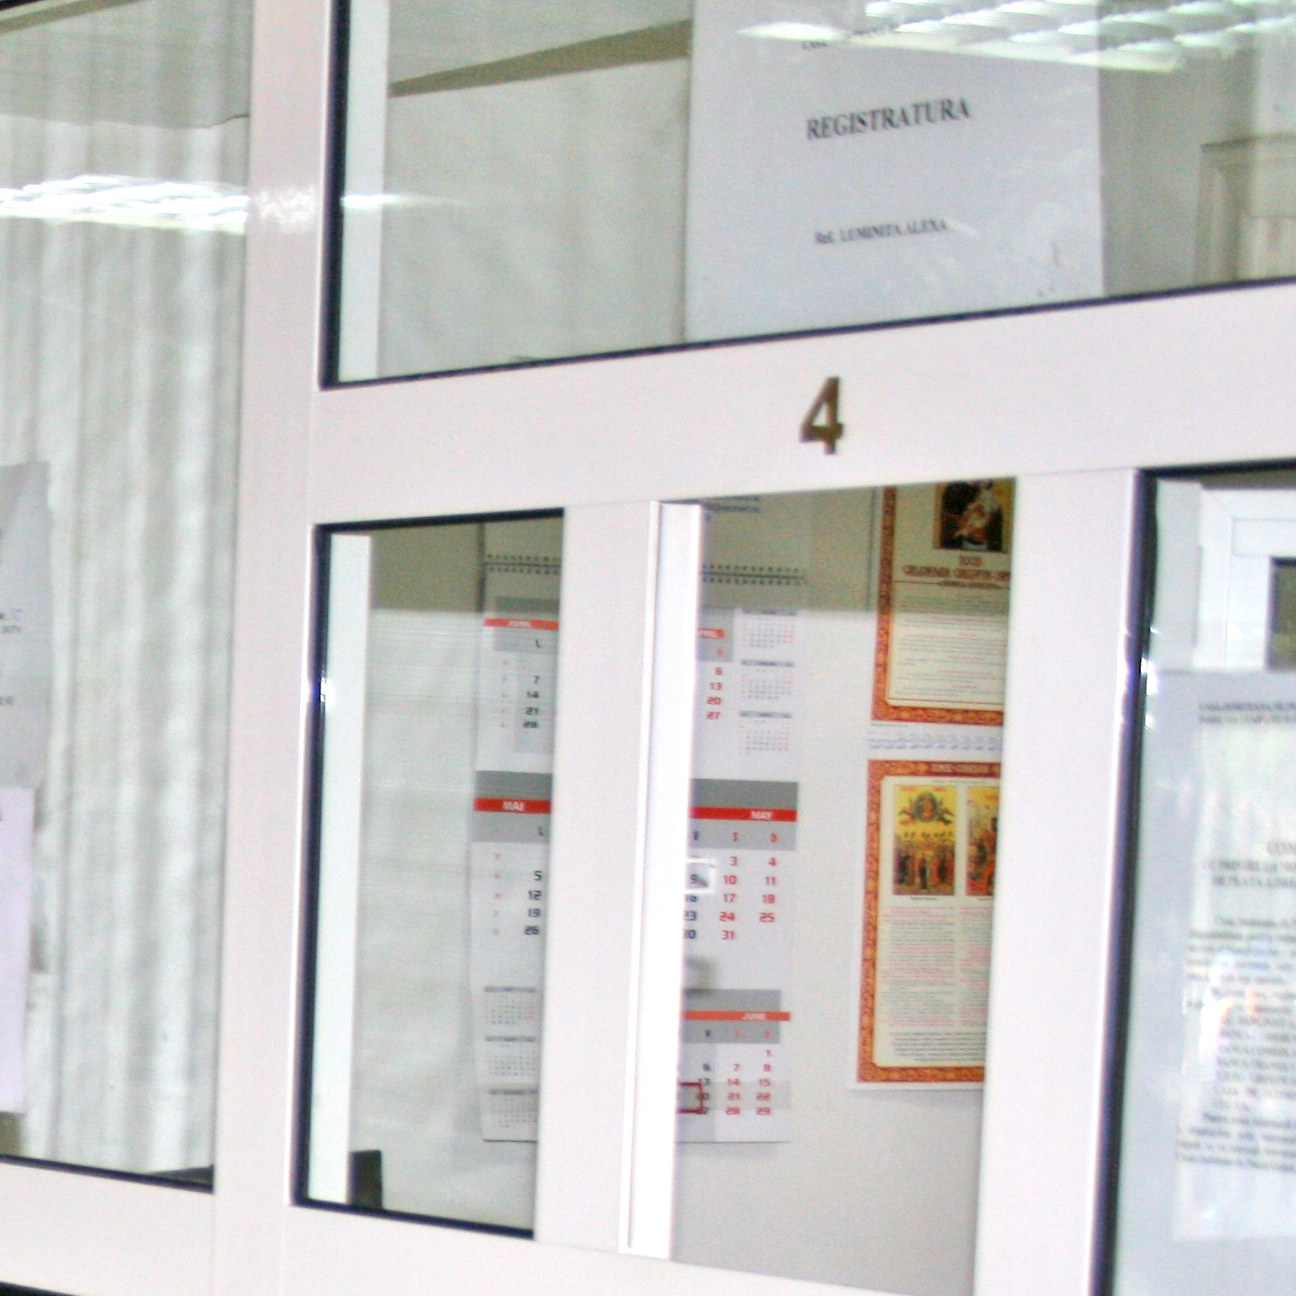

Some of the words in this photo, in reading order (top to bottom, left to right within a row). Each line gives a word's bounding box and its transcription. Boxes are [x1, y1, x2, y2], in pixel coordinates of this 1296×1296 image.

[806, 97, 971, 140] REGISTRATURA
[799, 375, 845, 455] 4
[502, 801, 525, 812] MAI
[730, 856, 738, 866] 3
[768, 857, 777, 867] 4
[534, 870, 542, 881] 5
[723, 875, 737, 885] 10
[765, 876, 776, 886] 11
[528, 890, 541, 900] 12
[723, 893, 736, 903] 17
[528, 907, 540, 918] 19
[719, 912, 735, 921] 24
[759, 912, 775, 922] 25
[524, 925, 540, 935] 26
[722, 930, 735, 940] 31
